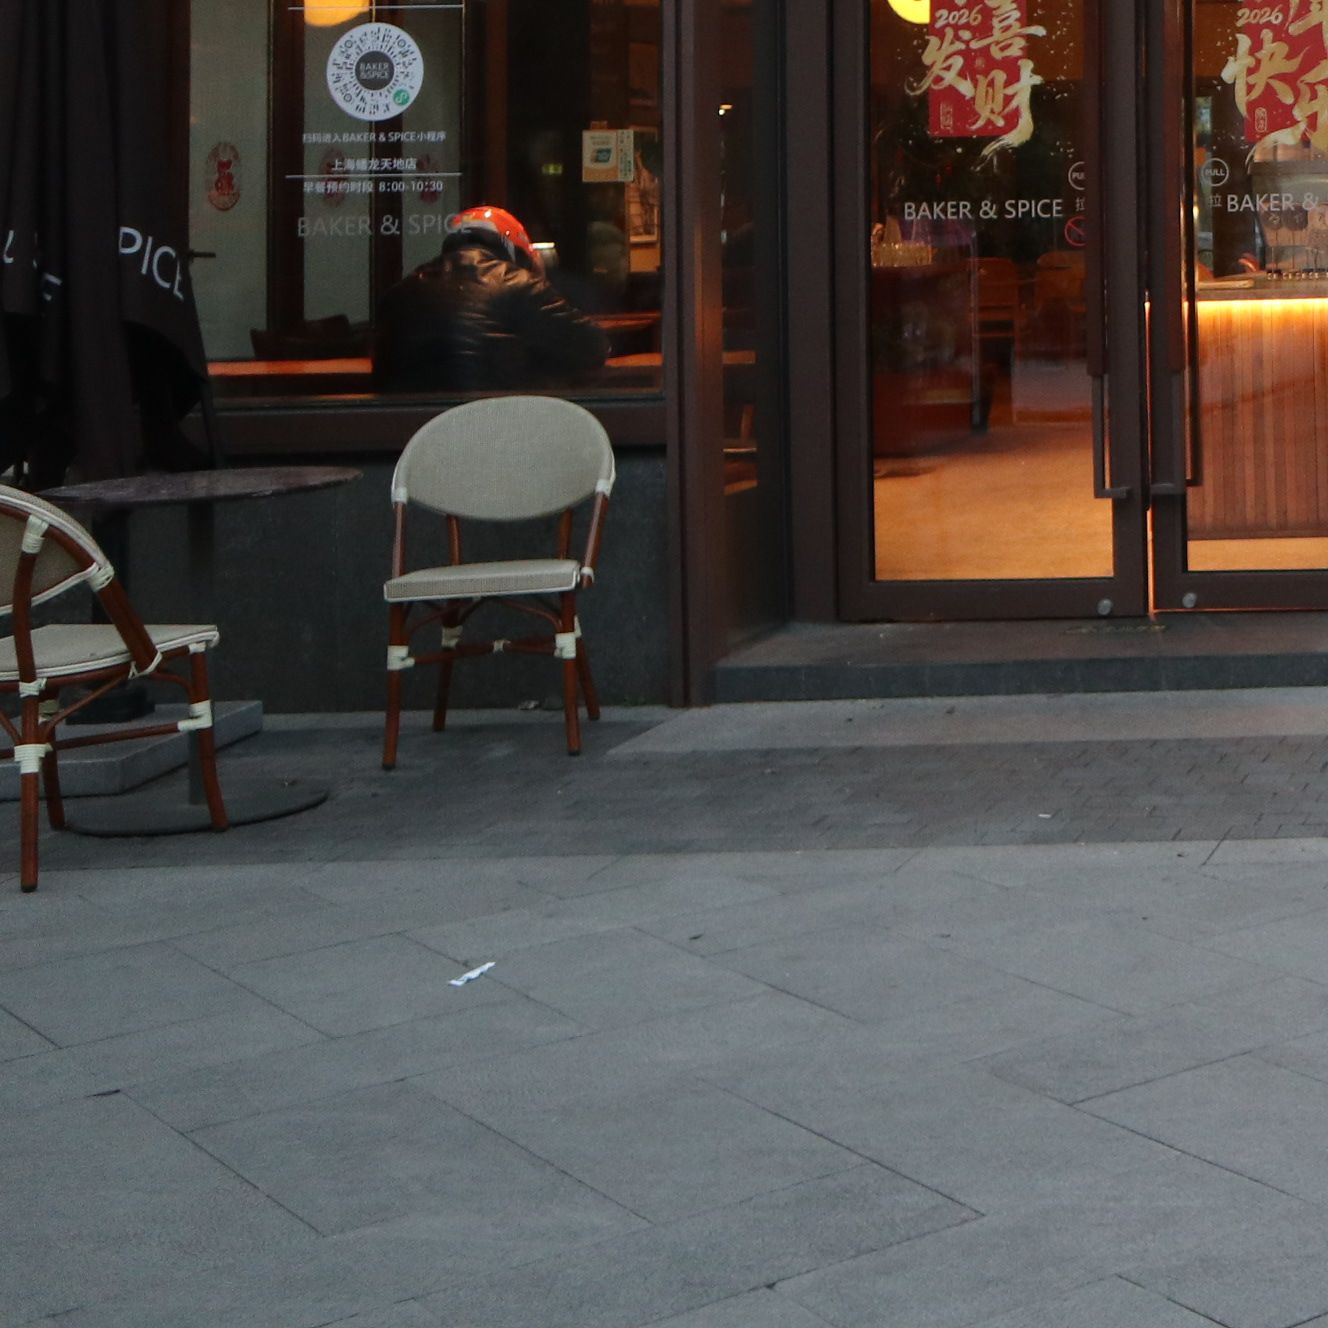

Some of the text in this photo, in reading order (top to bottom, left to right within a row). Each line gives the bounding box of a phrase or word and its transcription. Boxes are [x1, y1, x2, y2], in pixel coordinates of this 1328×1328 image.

[935, 5, 984, 27] 2026
[1235, 5, 1284, 27] 2026
[359, 62, 389, 71] BAKER
[1205, 167, 1226, 177] PULL
[378, 180, 444, 193] 8:00-10:30
[904, 199, 1064, 220] BAKER & SPICE
[1227, 193, 1295, 212] BAKER
[1302, 192, 1320, 211] &
[298, 213, 472, 236] BAKER & SPICE
